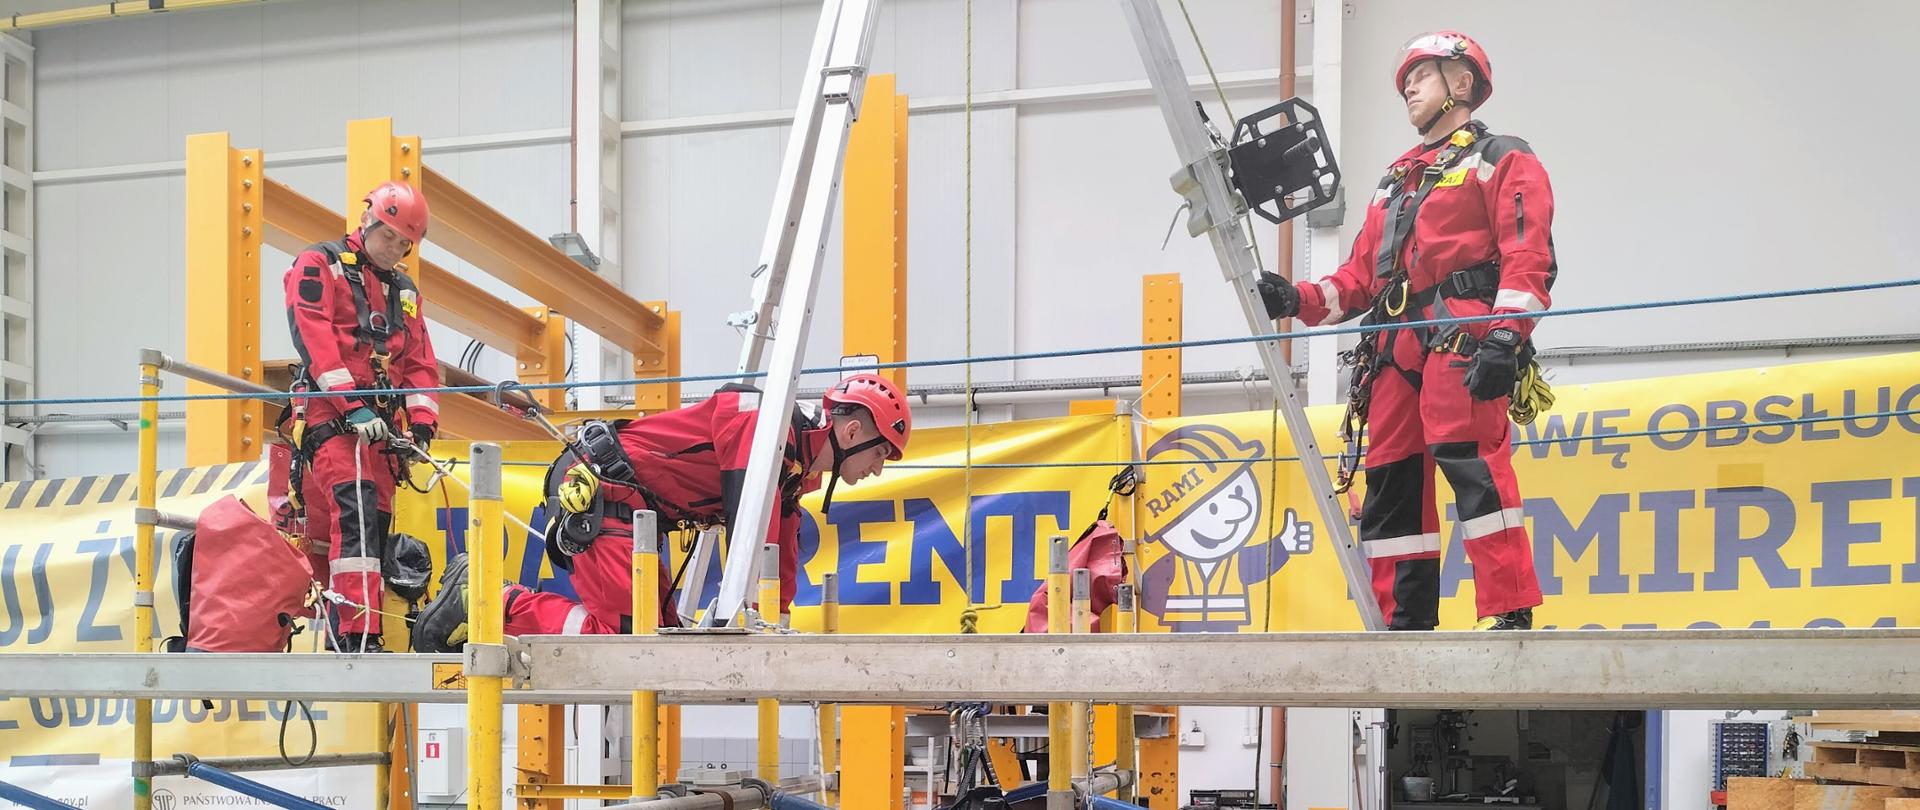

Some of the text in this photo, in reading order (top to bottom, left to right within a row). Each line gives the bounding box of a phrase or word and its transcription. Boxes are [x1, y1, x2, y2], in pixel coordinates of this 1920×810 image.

[1146, 467, 1205, 519] RAMI
[183, 793, 252, 806] PAŃSTWOWA
[313, 795, 349, 806] PRACY
